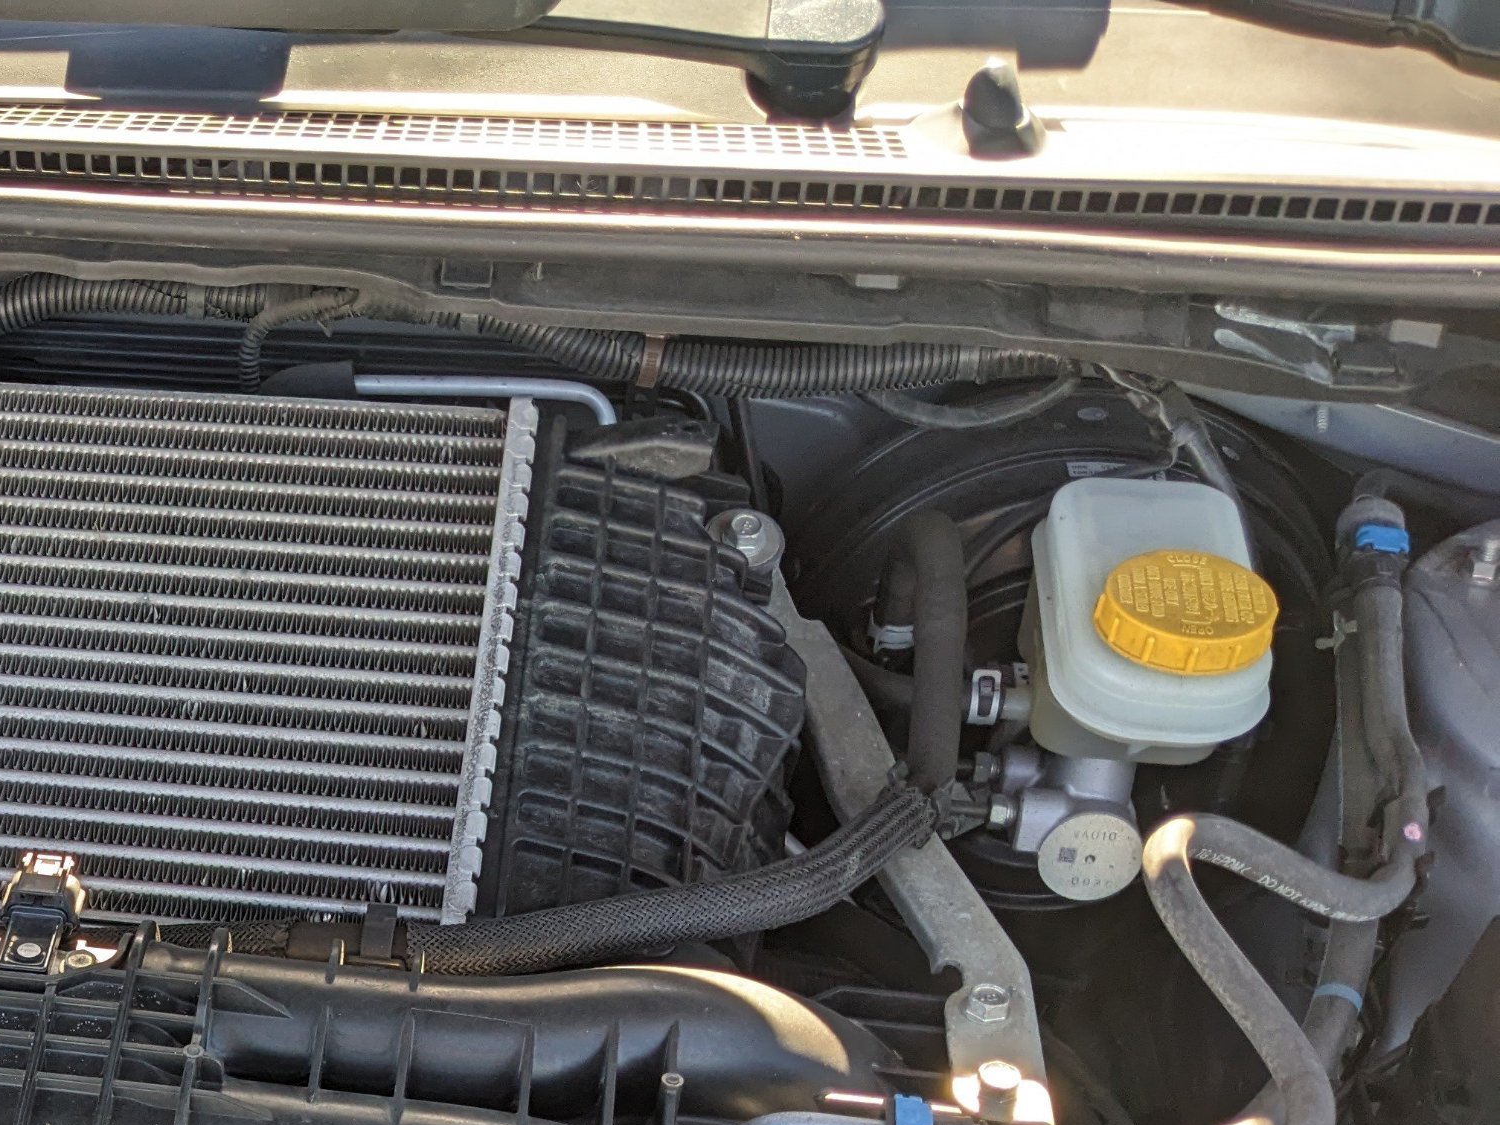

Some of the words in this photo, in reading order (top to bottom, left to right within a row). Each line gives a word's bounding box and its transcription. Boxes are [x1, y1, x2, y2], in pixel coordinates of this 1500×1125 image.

[1166, 554, 1208, 565] CLOSE
[1181, 624, 1214, 635] OPEN
[1274, 883, 1303, 900] NOT
